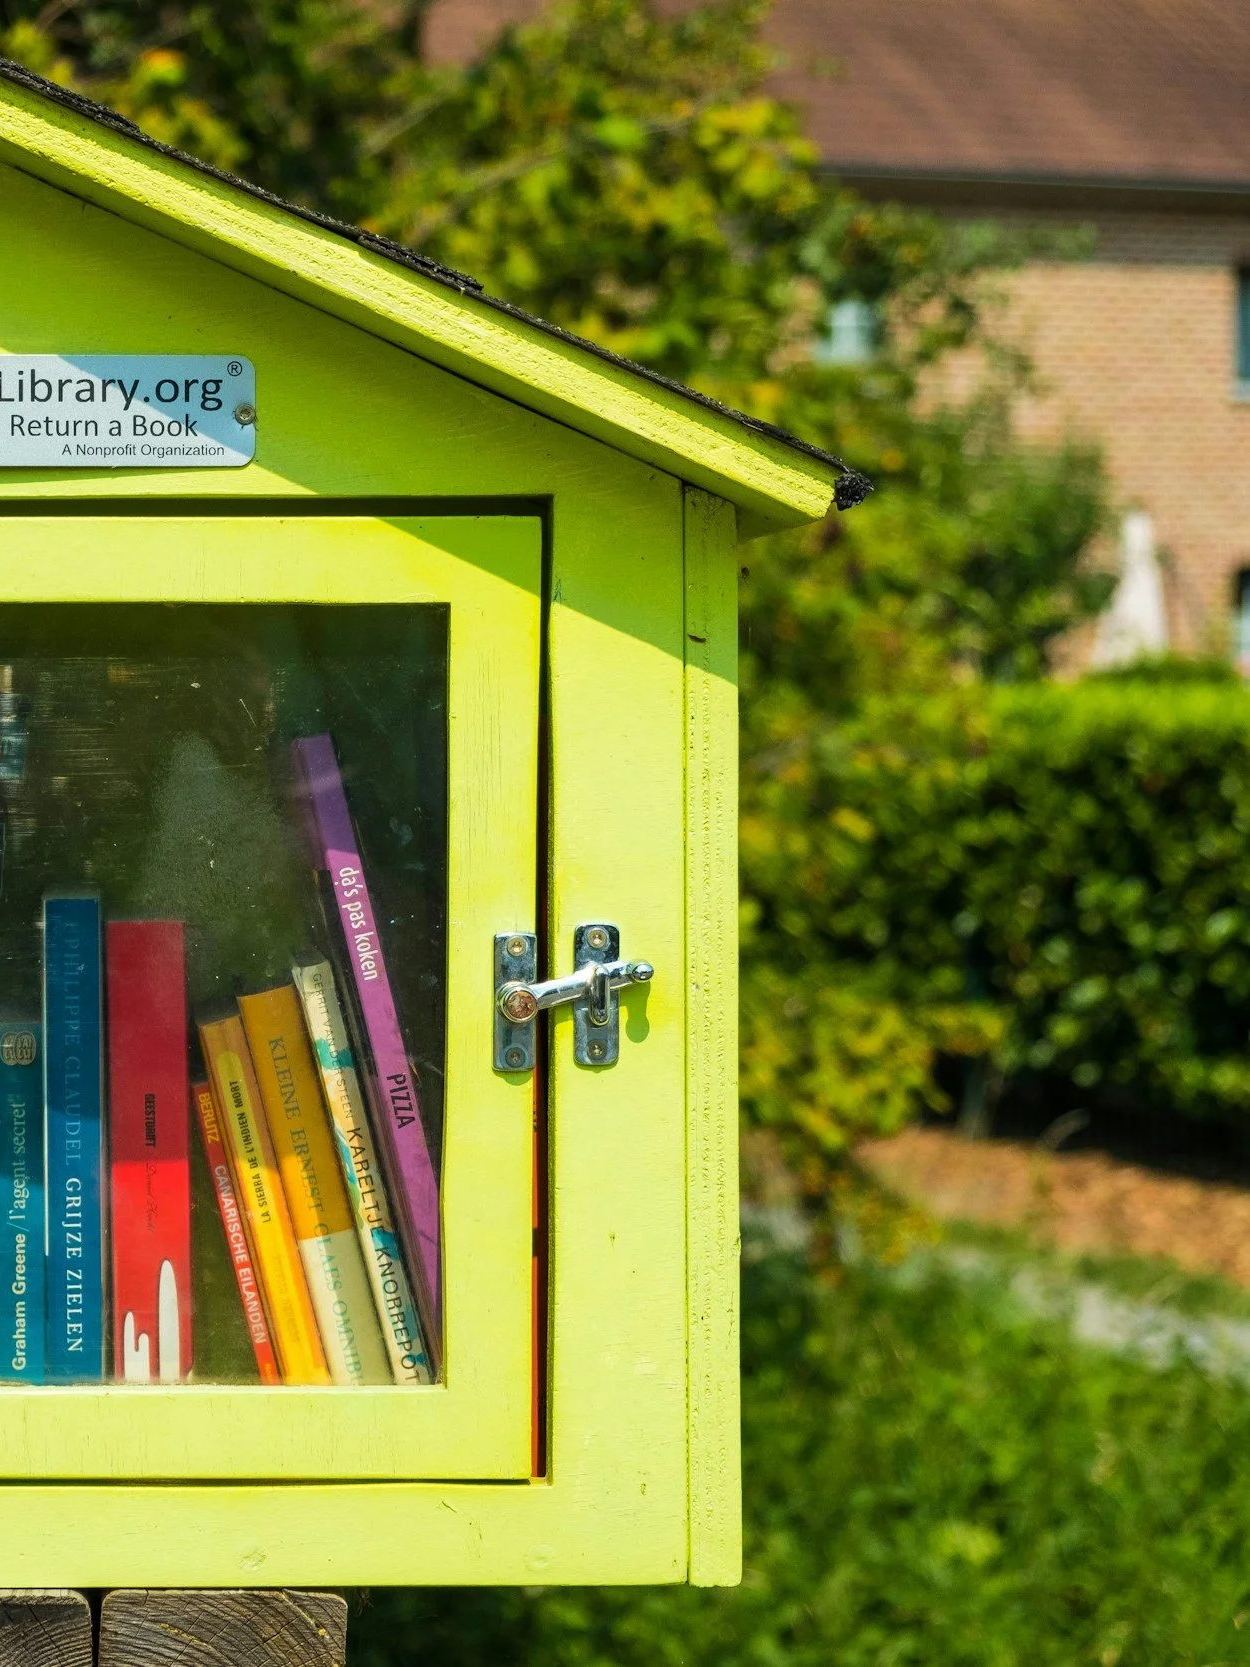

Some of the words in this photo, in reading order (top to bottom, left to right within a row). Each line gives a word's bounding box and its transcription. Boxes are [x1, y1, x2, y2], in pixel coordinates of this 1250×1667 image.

[10, 414, 99, 438] Return
[108, 420, 122, 438] a
[133, 414, 198, 438] Book
[62, 444, 72, 457] A
[77, 443, 136, 459] Nonprofit
[141, 443, 225, 459] Organization
[338, 866, 364, 897] da's
[342, 900, 365, 929] pas
[354, 931, 379, 981] koken
[64, 938, 81, 1046] PHILIPPE
[312, 974, 329, 1015] GERRIT
[323, 1019, 336, 1047] VAN
[328, 1050, 341, 1076] DER
[64, 1056, 81, 1166] CLAUDEL
[229, 1080, 244, 1109] MORT
[334, 1078, 354, 1119] STEEN
[387, 1072, 416, 1128] PIZZA
[9, 1101, 26, 1155] secret
[236, 1112, 255, 1153] L'INDIEN
[246, 1157, 259, 1169] DE
[251, 1174, 268, 1207] SIERRA
[269, 1037, 301, 1120] KLEINE
[290, 1129, 324, 1212] ERNEST
[314, 1223, 343, 1291] CLAES
[332, 1301, 364, 1381] OMNIB
[61, 1177, 83, 1259] GRIJZE
[197, 1092, 220, 1144] BERLITZ
[213, 1164, 248, 1265] CANARISCHE
[237, 1267, 267, 1344] EILANDEN
[257, 1210, 272, 1224] LA
[11, 1234, 27, 1296] Greene
[347, 1127, 384, 1238] KARELTJE
[375, 1246, 420, 1381] KNORREPOT
[65, 1269, 84, 1352] ZIELEN
[11, 1301, 27, 1371] Graham
